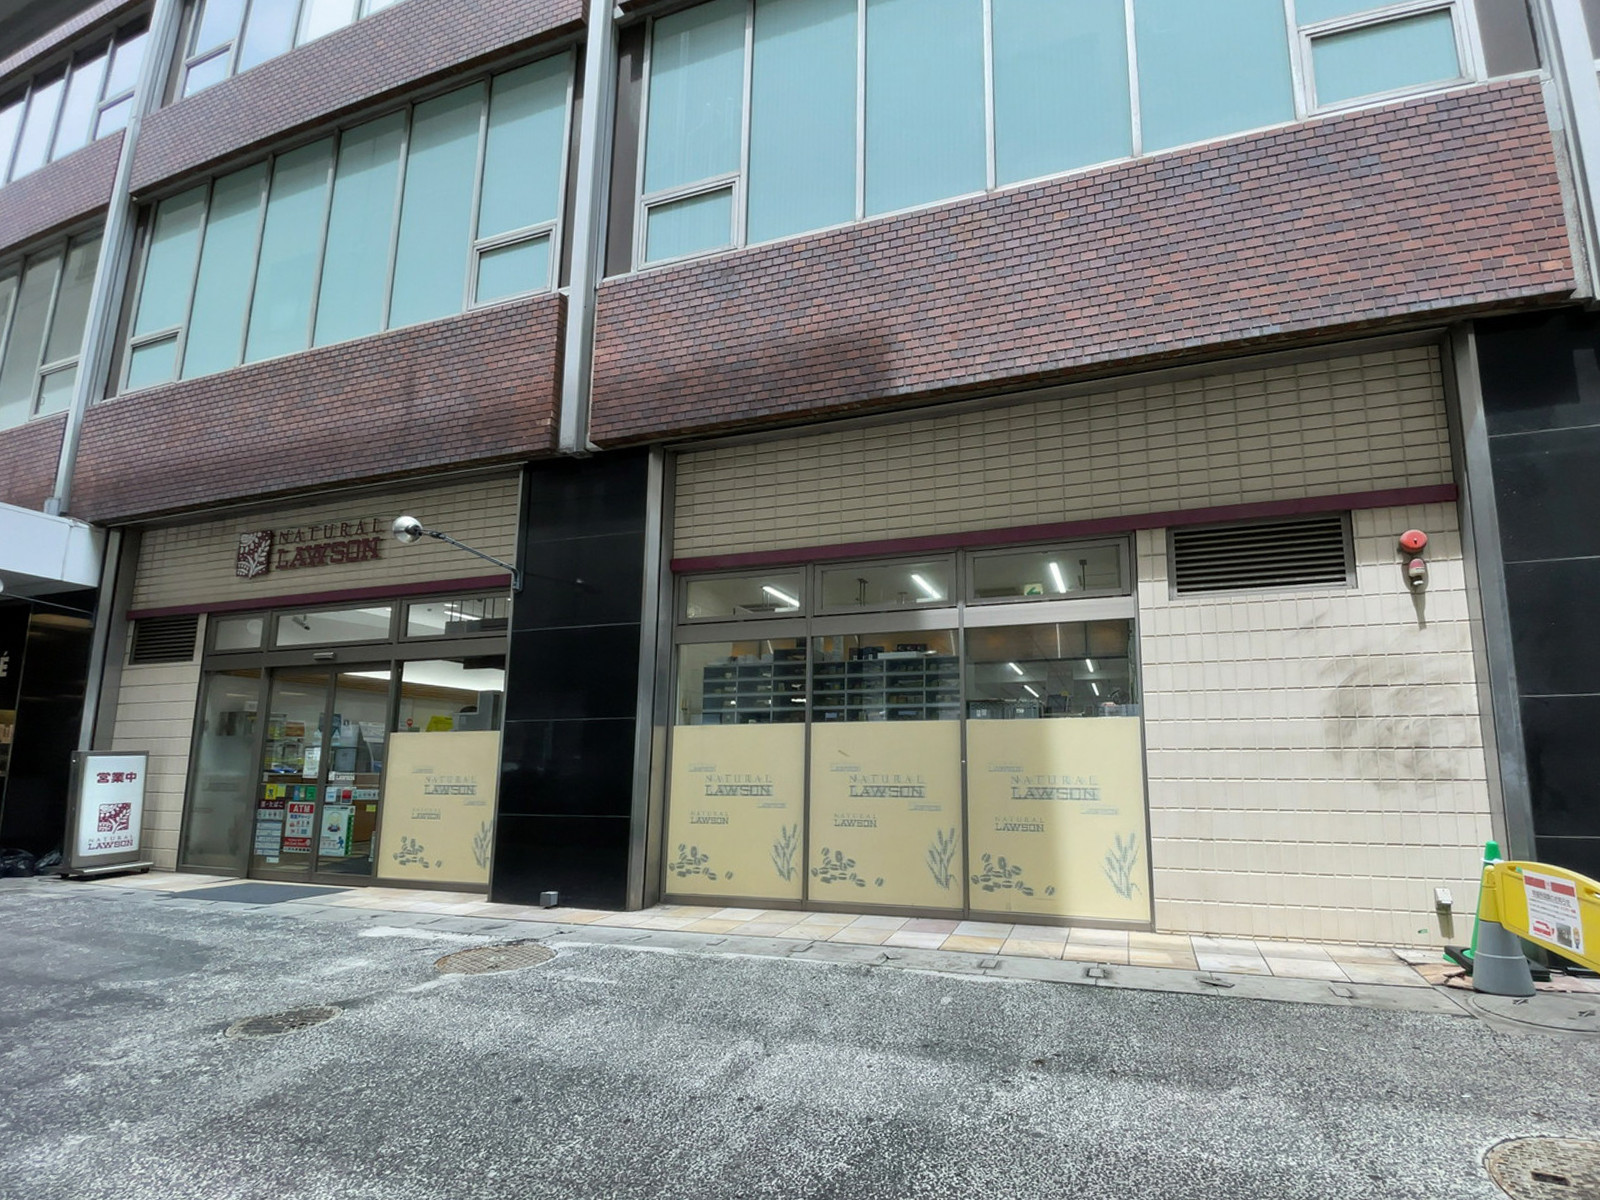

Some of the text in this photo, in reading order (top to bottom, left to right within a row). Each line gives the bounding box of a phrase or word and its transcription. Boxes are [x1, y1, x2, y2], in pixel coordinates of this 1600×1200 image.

[279, 518, 384, 544] NATURAL
[275, 536, 382, 569] LAWSON
[97, 772, 137, 783] 営業中
[705, 774, 772, 783] NATURAL
[849, 774, 924, 784] NATURAL
[1011, 775, 1098, 785] NATURAL
[424, 785, 477, 795] LAWSON
[704, 785, 773, 796] LAWSON
[849, 785, 925, 798] LAWSON
[1011, 787, 1101, 800] LAWSON
[834, 819, 877, 827] LAWSON
[995, 823, 1045, 832] LAWSON
[88, 840, 134, 850] LAWSON
